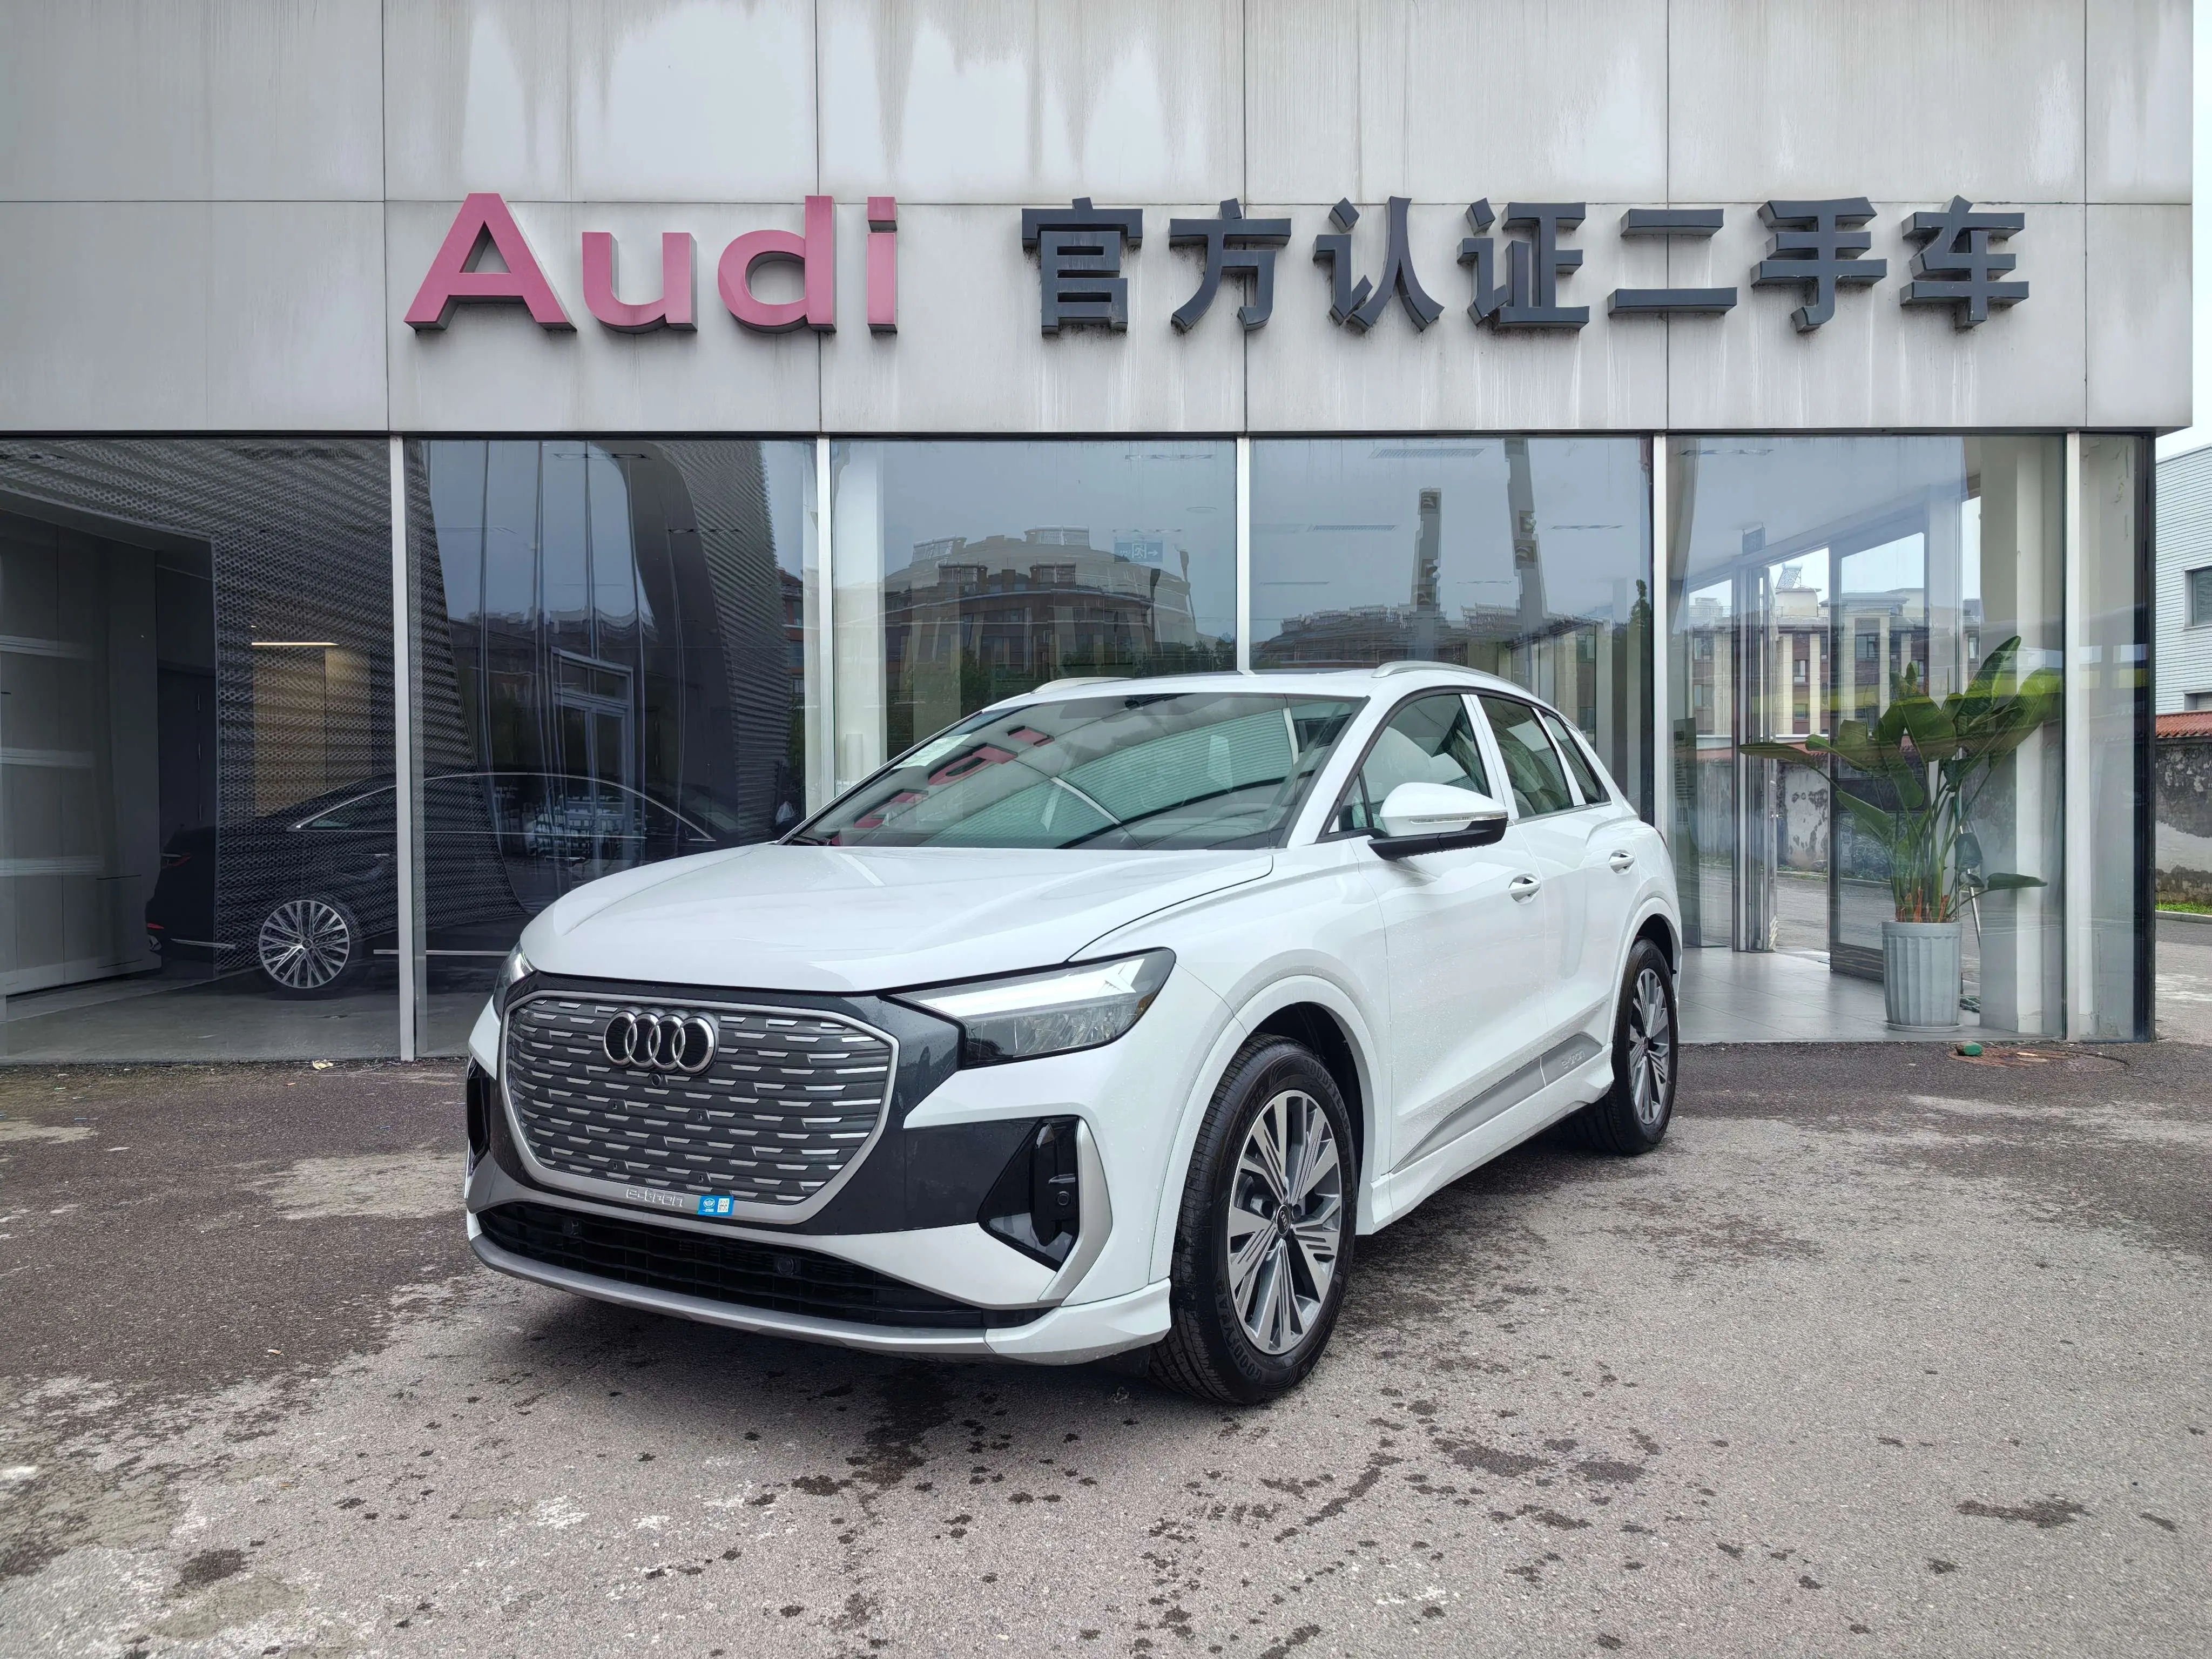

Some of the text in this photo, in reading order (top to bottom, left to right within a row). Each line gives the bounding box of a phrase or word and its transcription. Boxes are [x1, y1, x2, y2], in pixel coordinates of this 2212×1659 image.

[404, 192, 2030, 334] Audi 官方认证二手车
[626, 1188, 684, 1207] e-tron
